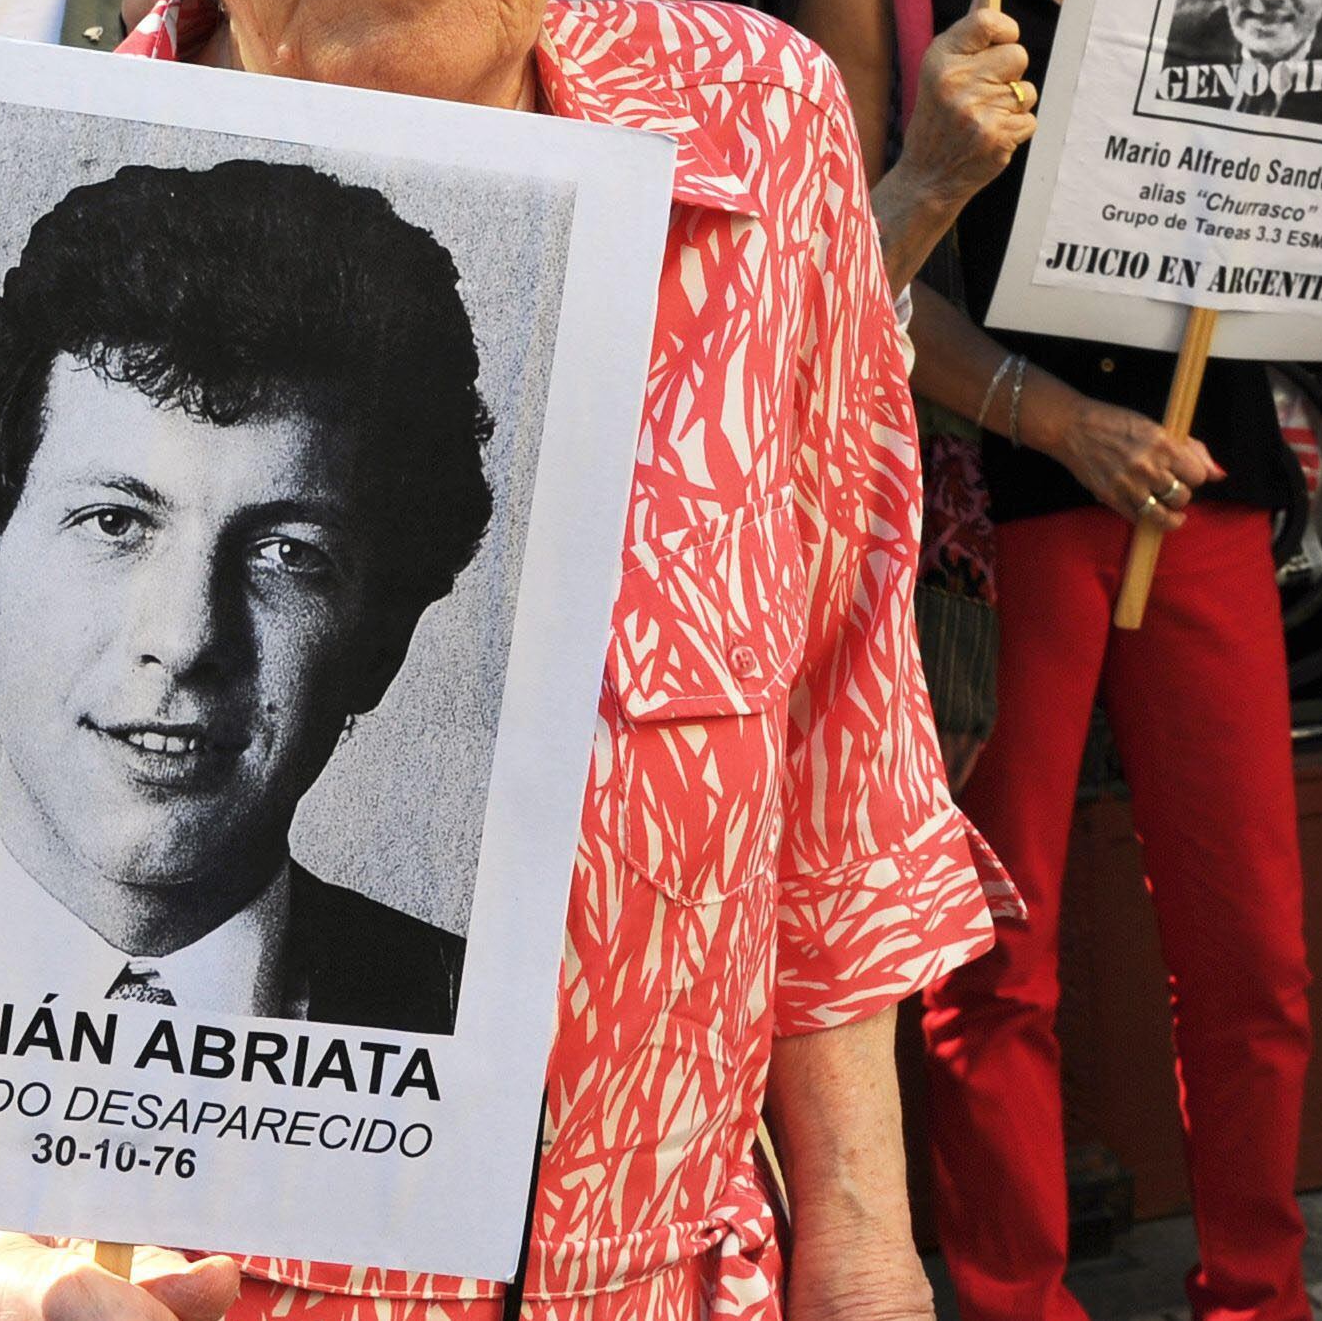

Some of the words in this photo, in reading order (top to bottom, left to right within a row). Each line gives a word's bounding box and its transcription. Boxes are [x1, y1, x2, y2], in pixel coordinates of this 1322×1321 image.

[1104, 135, 1171, 170] Mario
[1177, 145, 1261, 183] Alfredo
[1138, 182, 1187, 206] alias
[1101, 204, 1160, 232] Grupo
[1163, 212, 1188, 233] de
[1195, 218, 1252, 241] Tareas
[1255, 225, 1283, 245] 3.3
[1045, 242, 1151, 281] JUICIO
[1158, 256, 1202, 289] EN
[134, 1019, 443, 1102] ABRIATA
[63, 1085, 435, 1160] DESAPARECIDO
[30, 1132, 198, 1181] 30-10-76
